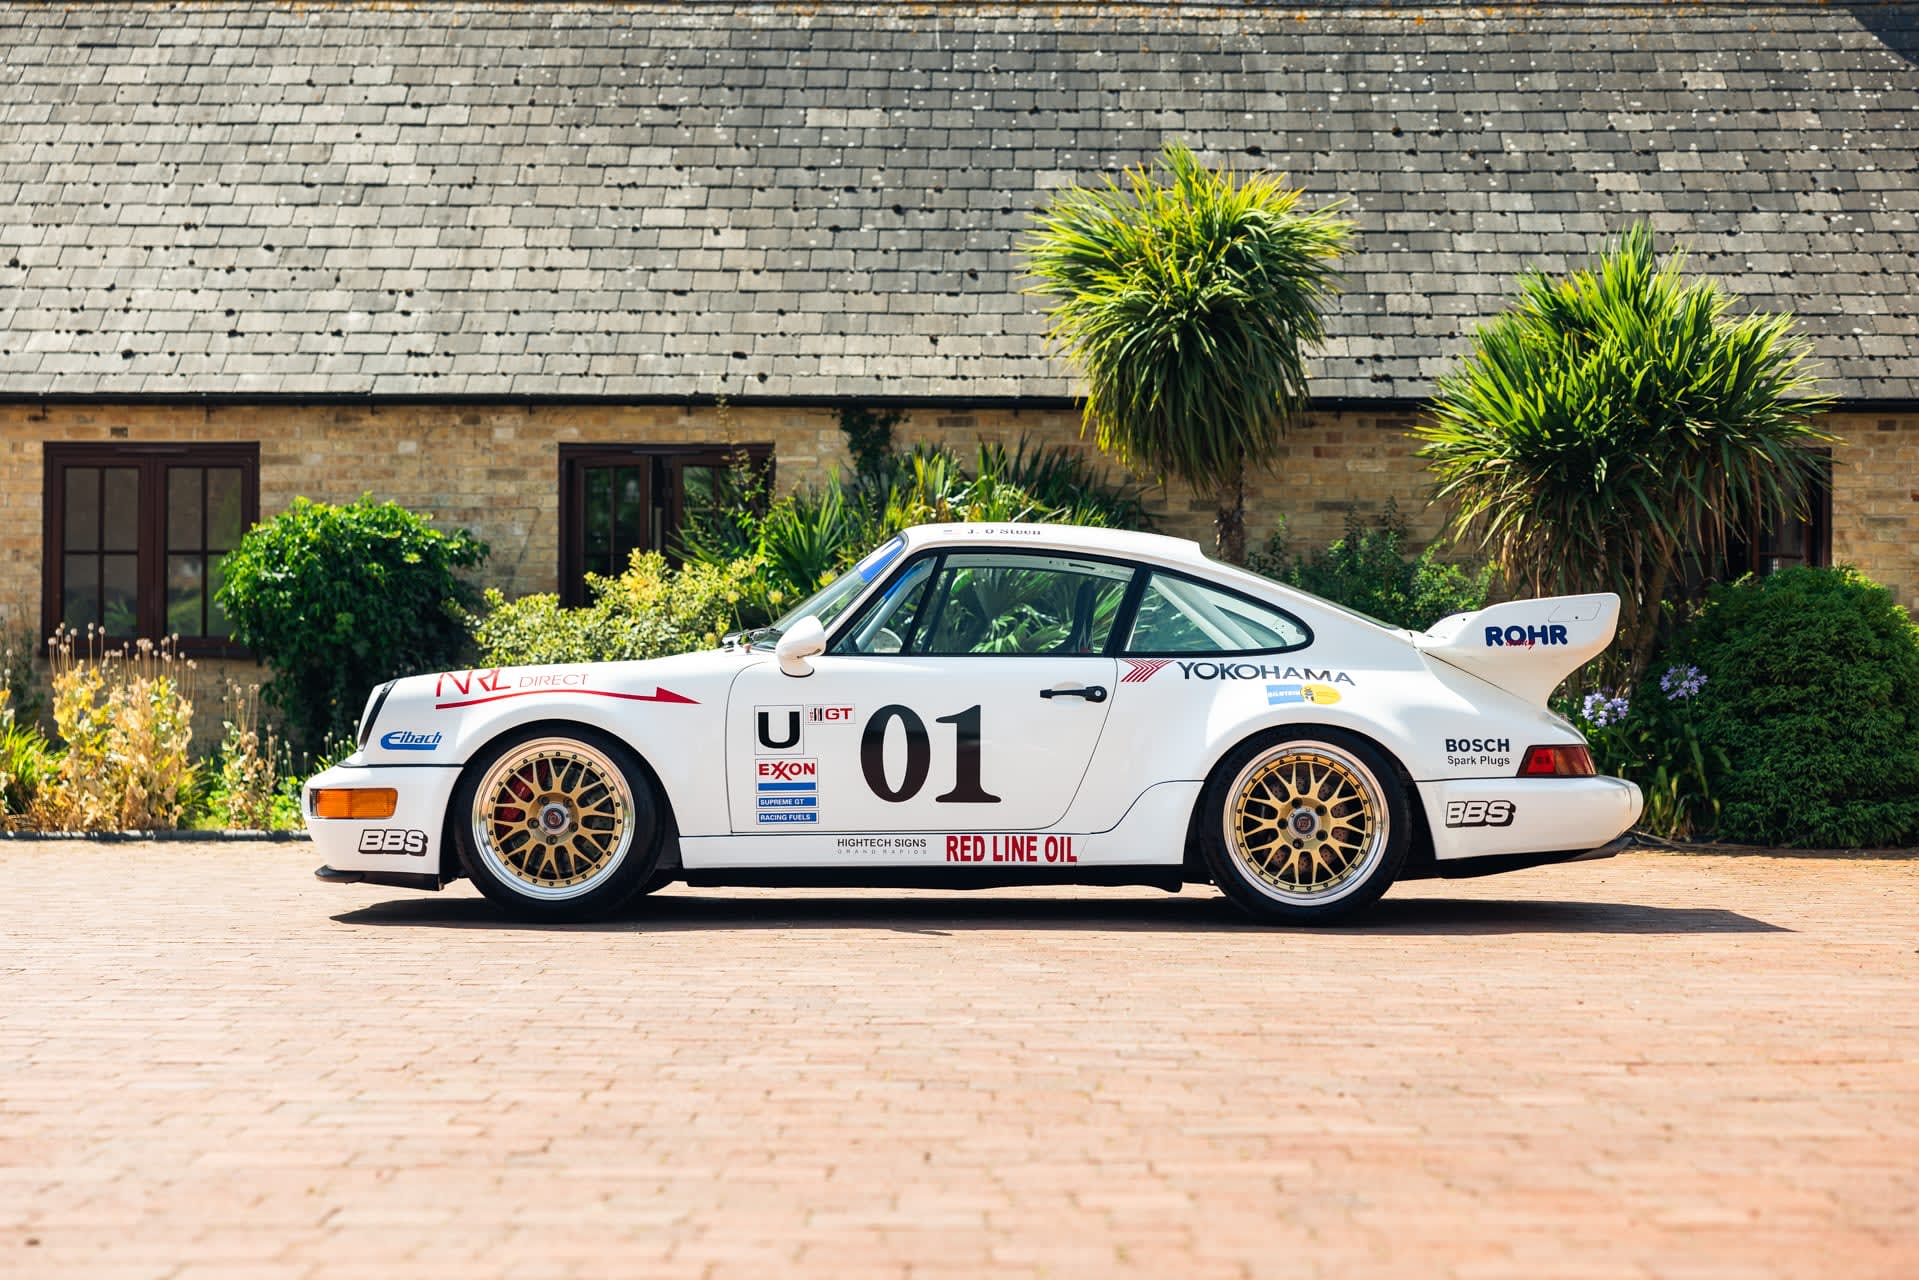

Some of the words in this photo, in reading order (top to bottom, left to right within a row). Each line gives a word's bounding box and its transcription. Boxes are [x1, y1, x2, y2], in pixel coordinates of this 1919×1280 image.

[1485, 625, 1568, 647] ROHR
[518, 673, 590, 688] DIRECT
[1176, 661, 1356, 686] YOKOHAMA
[825, 708, 853, 720] GT
[380, 730, 442, 751] Eibach
[758, 711, 800, 749] U
[860, 704, 1002, 803] 01
[1445, 739, 1510, 752] BOSCH
[758, 761, 816, 781] EXXON
[1447, 755, 1477, 766] Spark
[1480, 755, 1510, 767] Plugs
[759, 798, 793, 806] SUPREME
[1445, 800, 1516, 828] BBS
[358, 829, 428, 857] BBS
[837, 838, 892, 847] HIGHTECH
[894, 838, 927, 847] SIGNS
[946, 835, 985, 862] RED
[993, 835, 1037, 862] LINE
[1045, 836, 1077, 863] OIL
